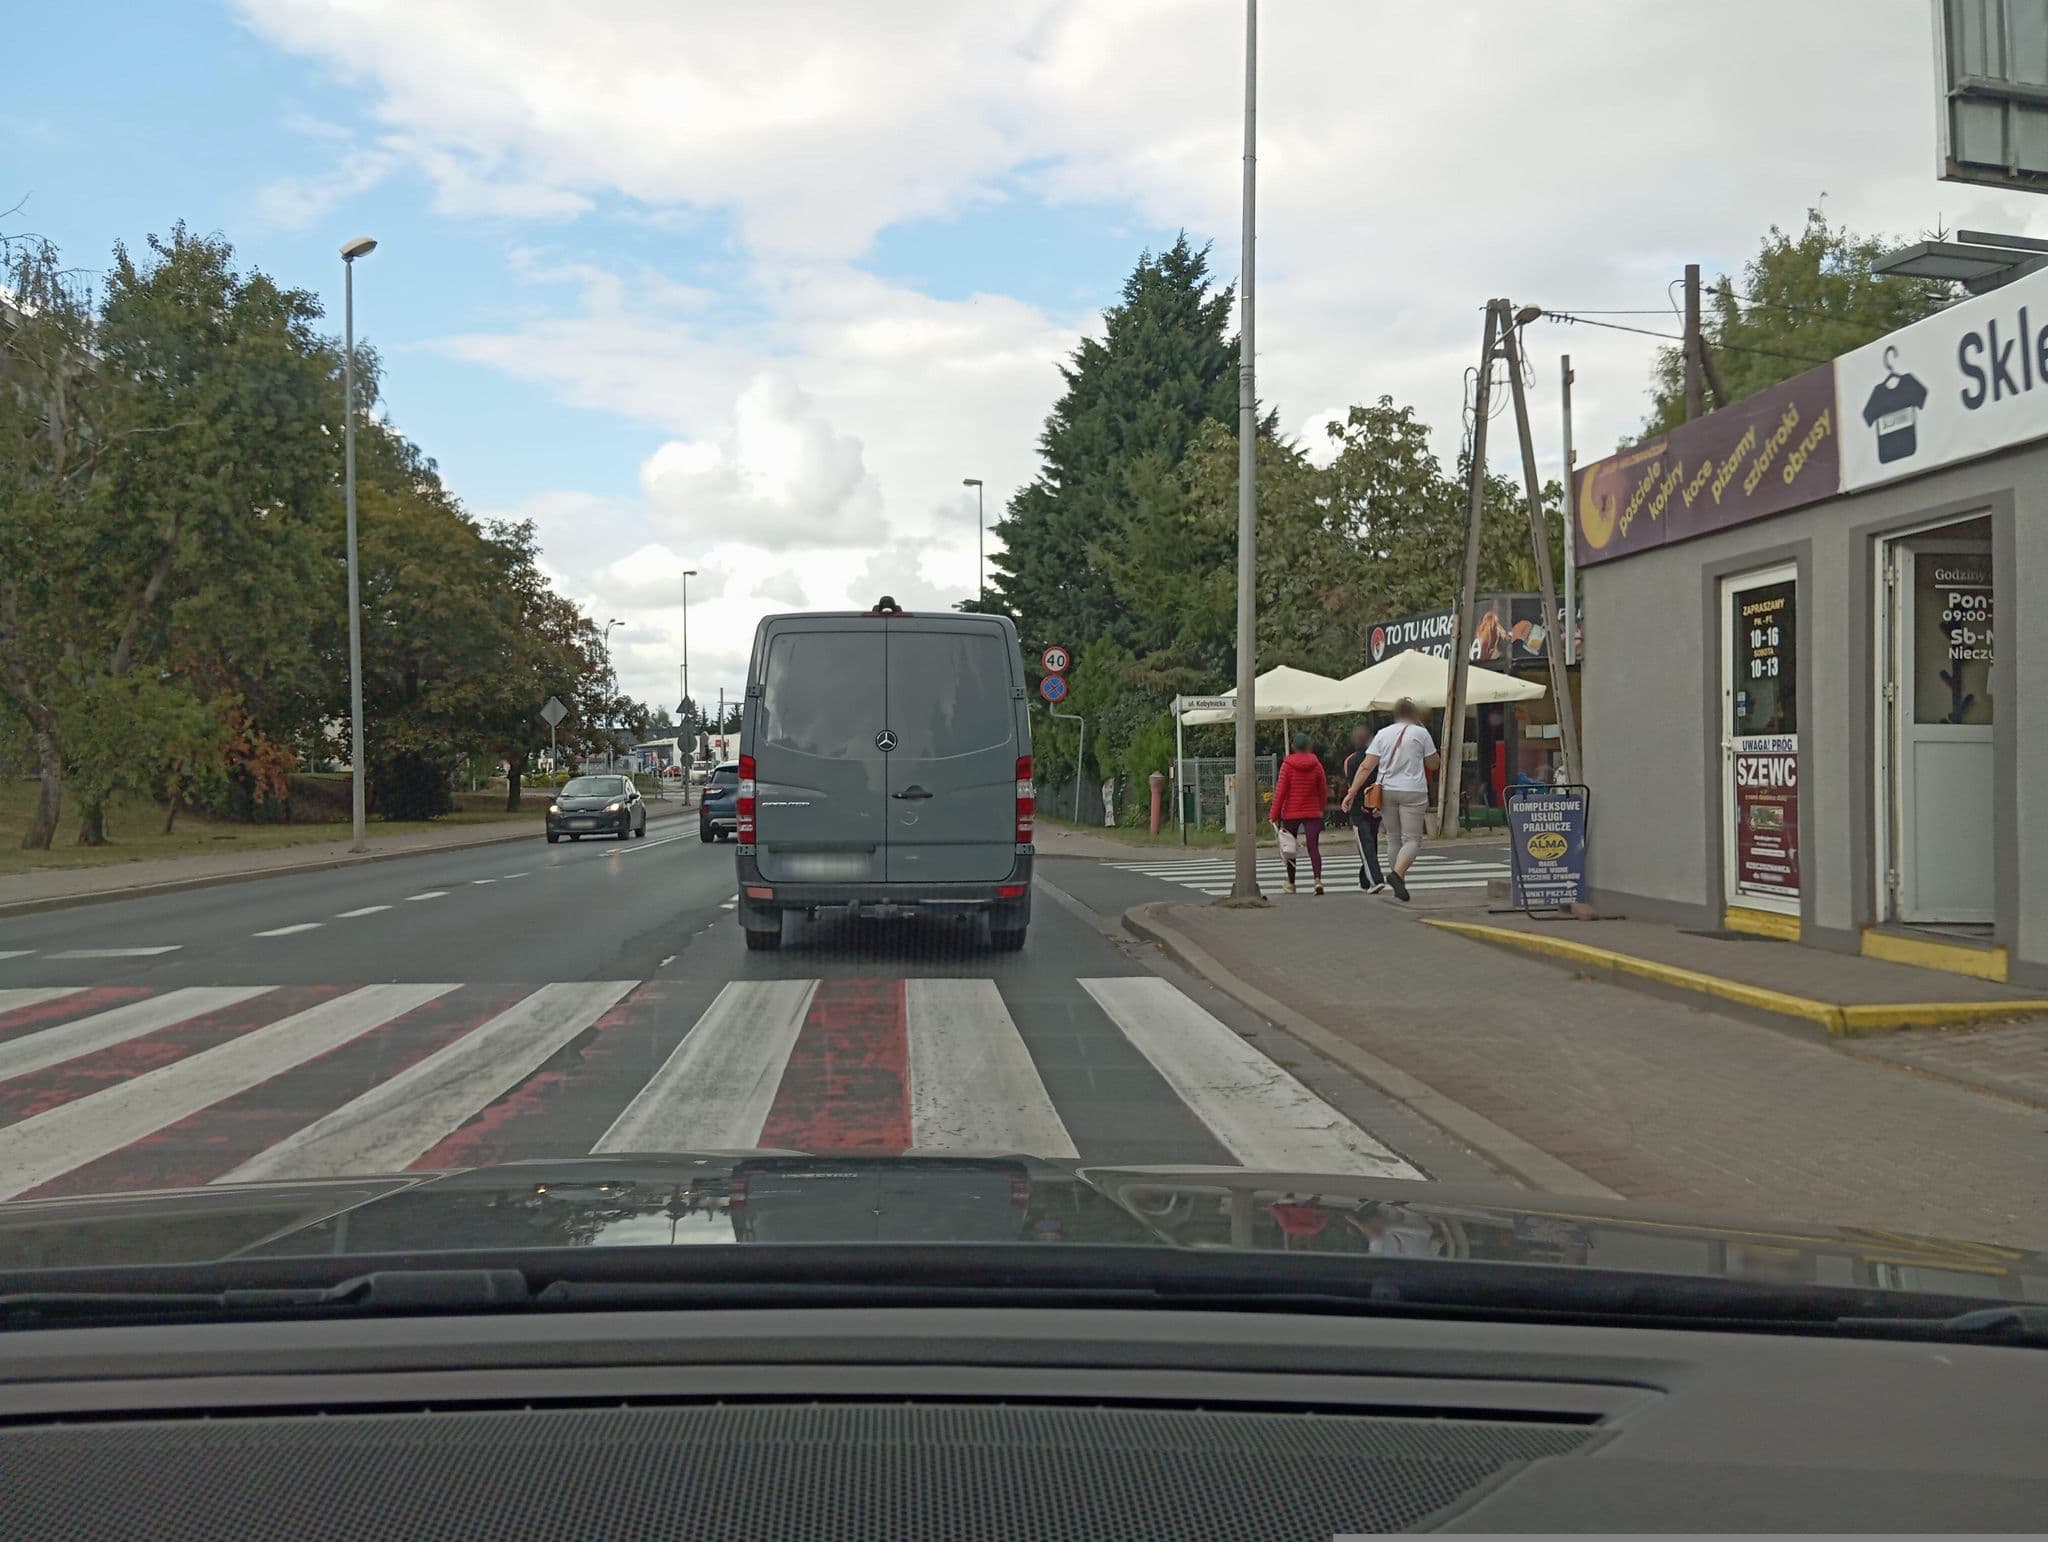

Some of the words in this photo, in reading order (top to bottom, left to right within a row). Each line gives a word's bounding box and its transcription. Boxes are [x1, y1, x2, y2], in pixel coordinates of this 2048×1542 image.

[1743, 401, 1800, 497] szlafroki
[1782, 408, 1832, 485] obrusy
[1711, 424, 1756, 505] piżamy
[1681, 459, 1713, 508] koce
[1935, 568, 1986, 582] Godziny
[1743, 598, 1785, 617] ZAPRASZAMY
[1385, 625, 1402, 645] TO
[1404, 620, 1420, 642] TU
[1750, 626, 1779, 649] 10-16
[1046, 654, 1065, 667] 40
[1750, 656, 1779, 679] 10-13
[1742, 738, 1770, 751] UWAGA!
[1771, 735, 1793, 751] PRÓG
[1737, 757, 1797, 787] SZEWC
[1513, 801, 1581, 812] KOMPLEKSOWE
[1532, 812, 1562, 822] USŁUGI
[1523, 822, 1571, 832] PRALNICZE
[1529, 839, 1566, 849] ALMA
